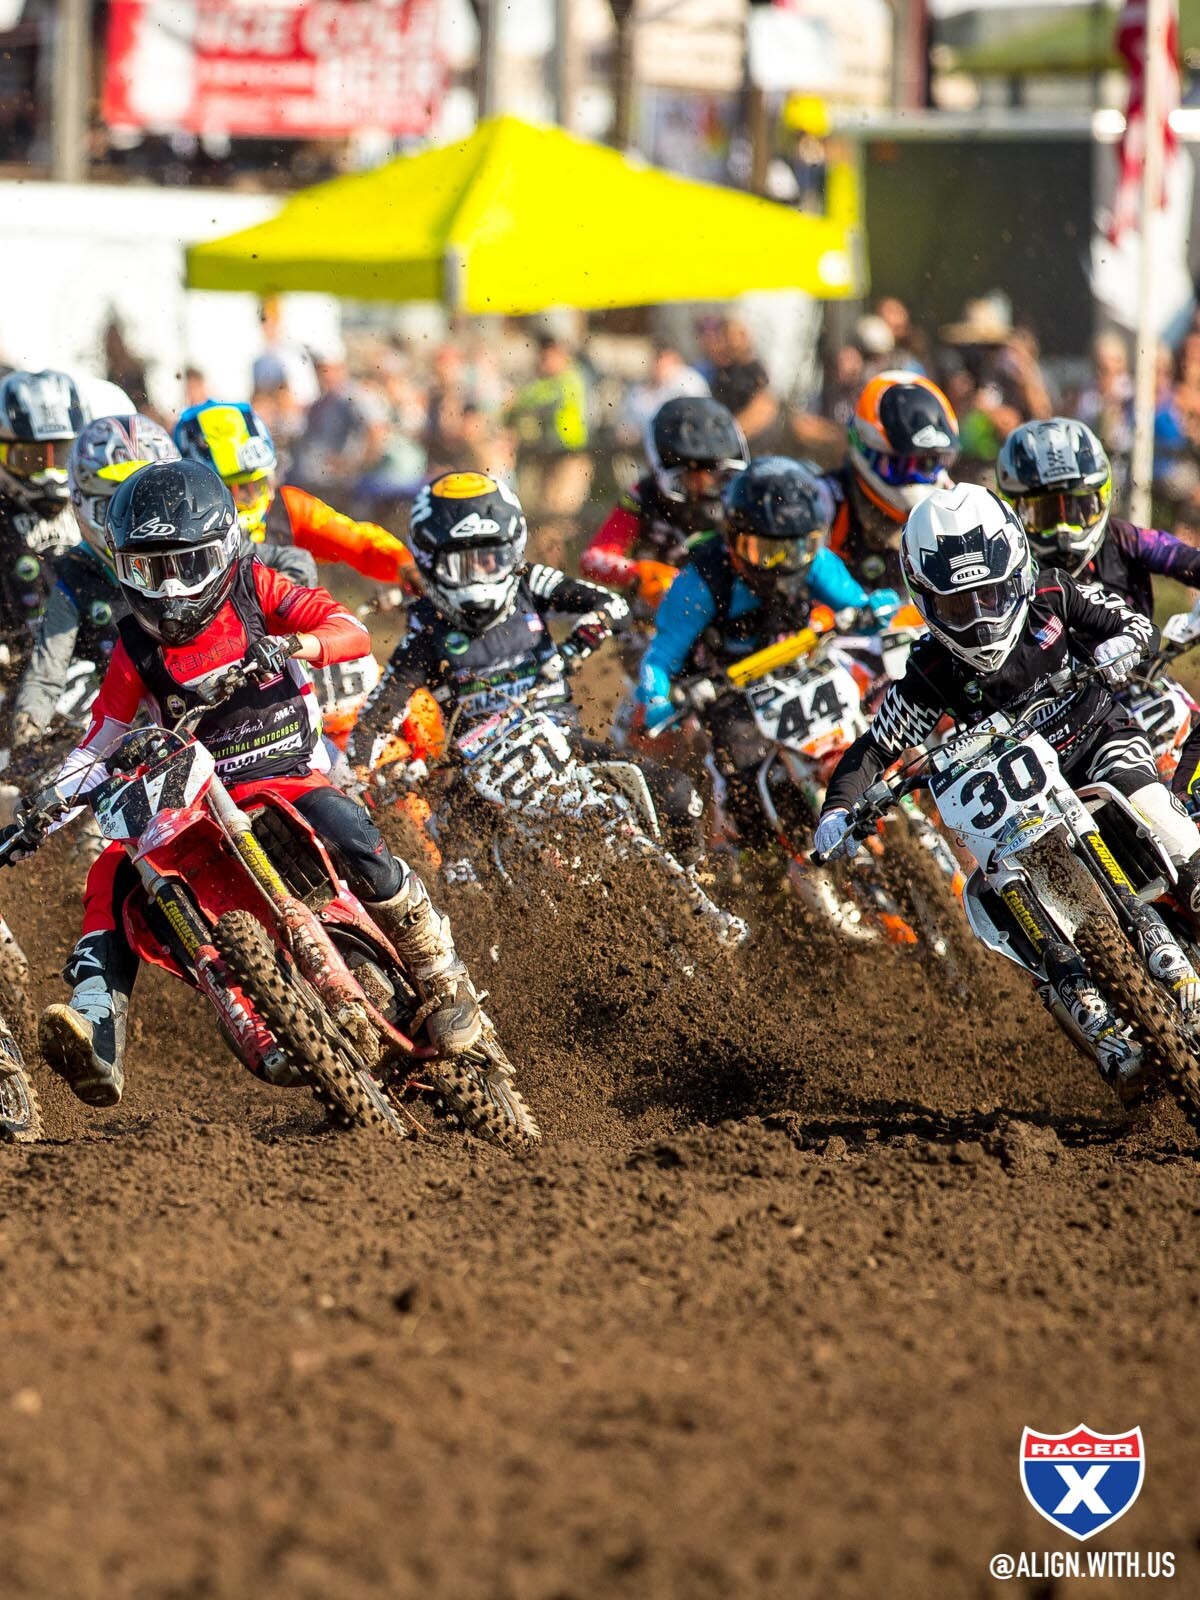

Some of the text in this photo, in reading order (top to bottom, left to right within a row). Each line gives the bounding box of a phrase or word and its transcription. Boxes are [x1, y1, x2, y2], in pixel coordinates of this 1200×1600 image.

[956, 568, 985, 581] BELL
[253, 720, 300, 748] MOTOCROSS
[273, 704, 297, 724] AMA
[775, 680, 848, 741] 44
[1046, 723, 1072, 744] 021
[960, 744, 1048, 830] 30
[1087, 834, 1126, 885] Factory
[163, 897, 201, 950] Factory
[1004, 888, 1044, 942] Factory
